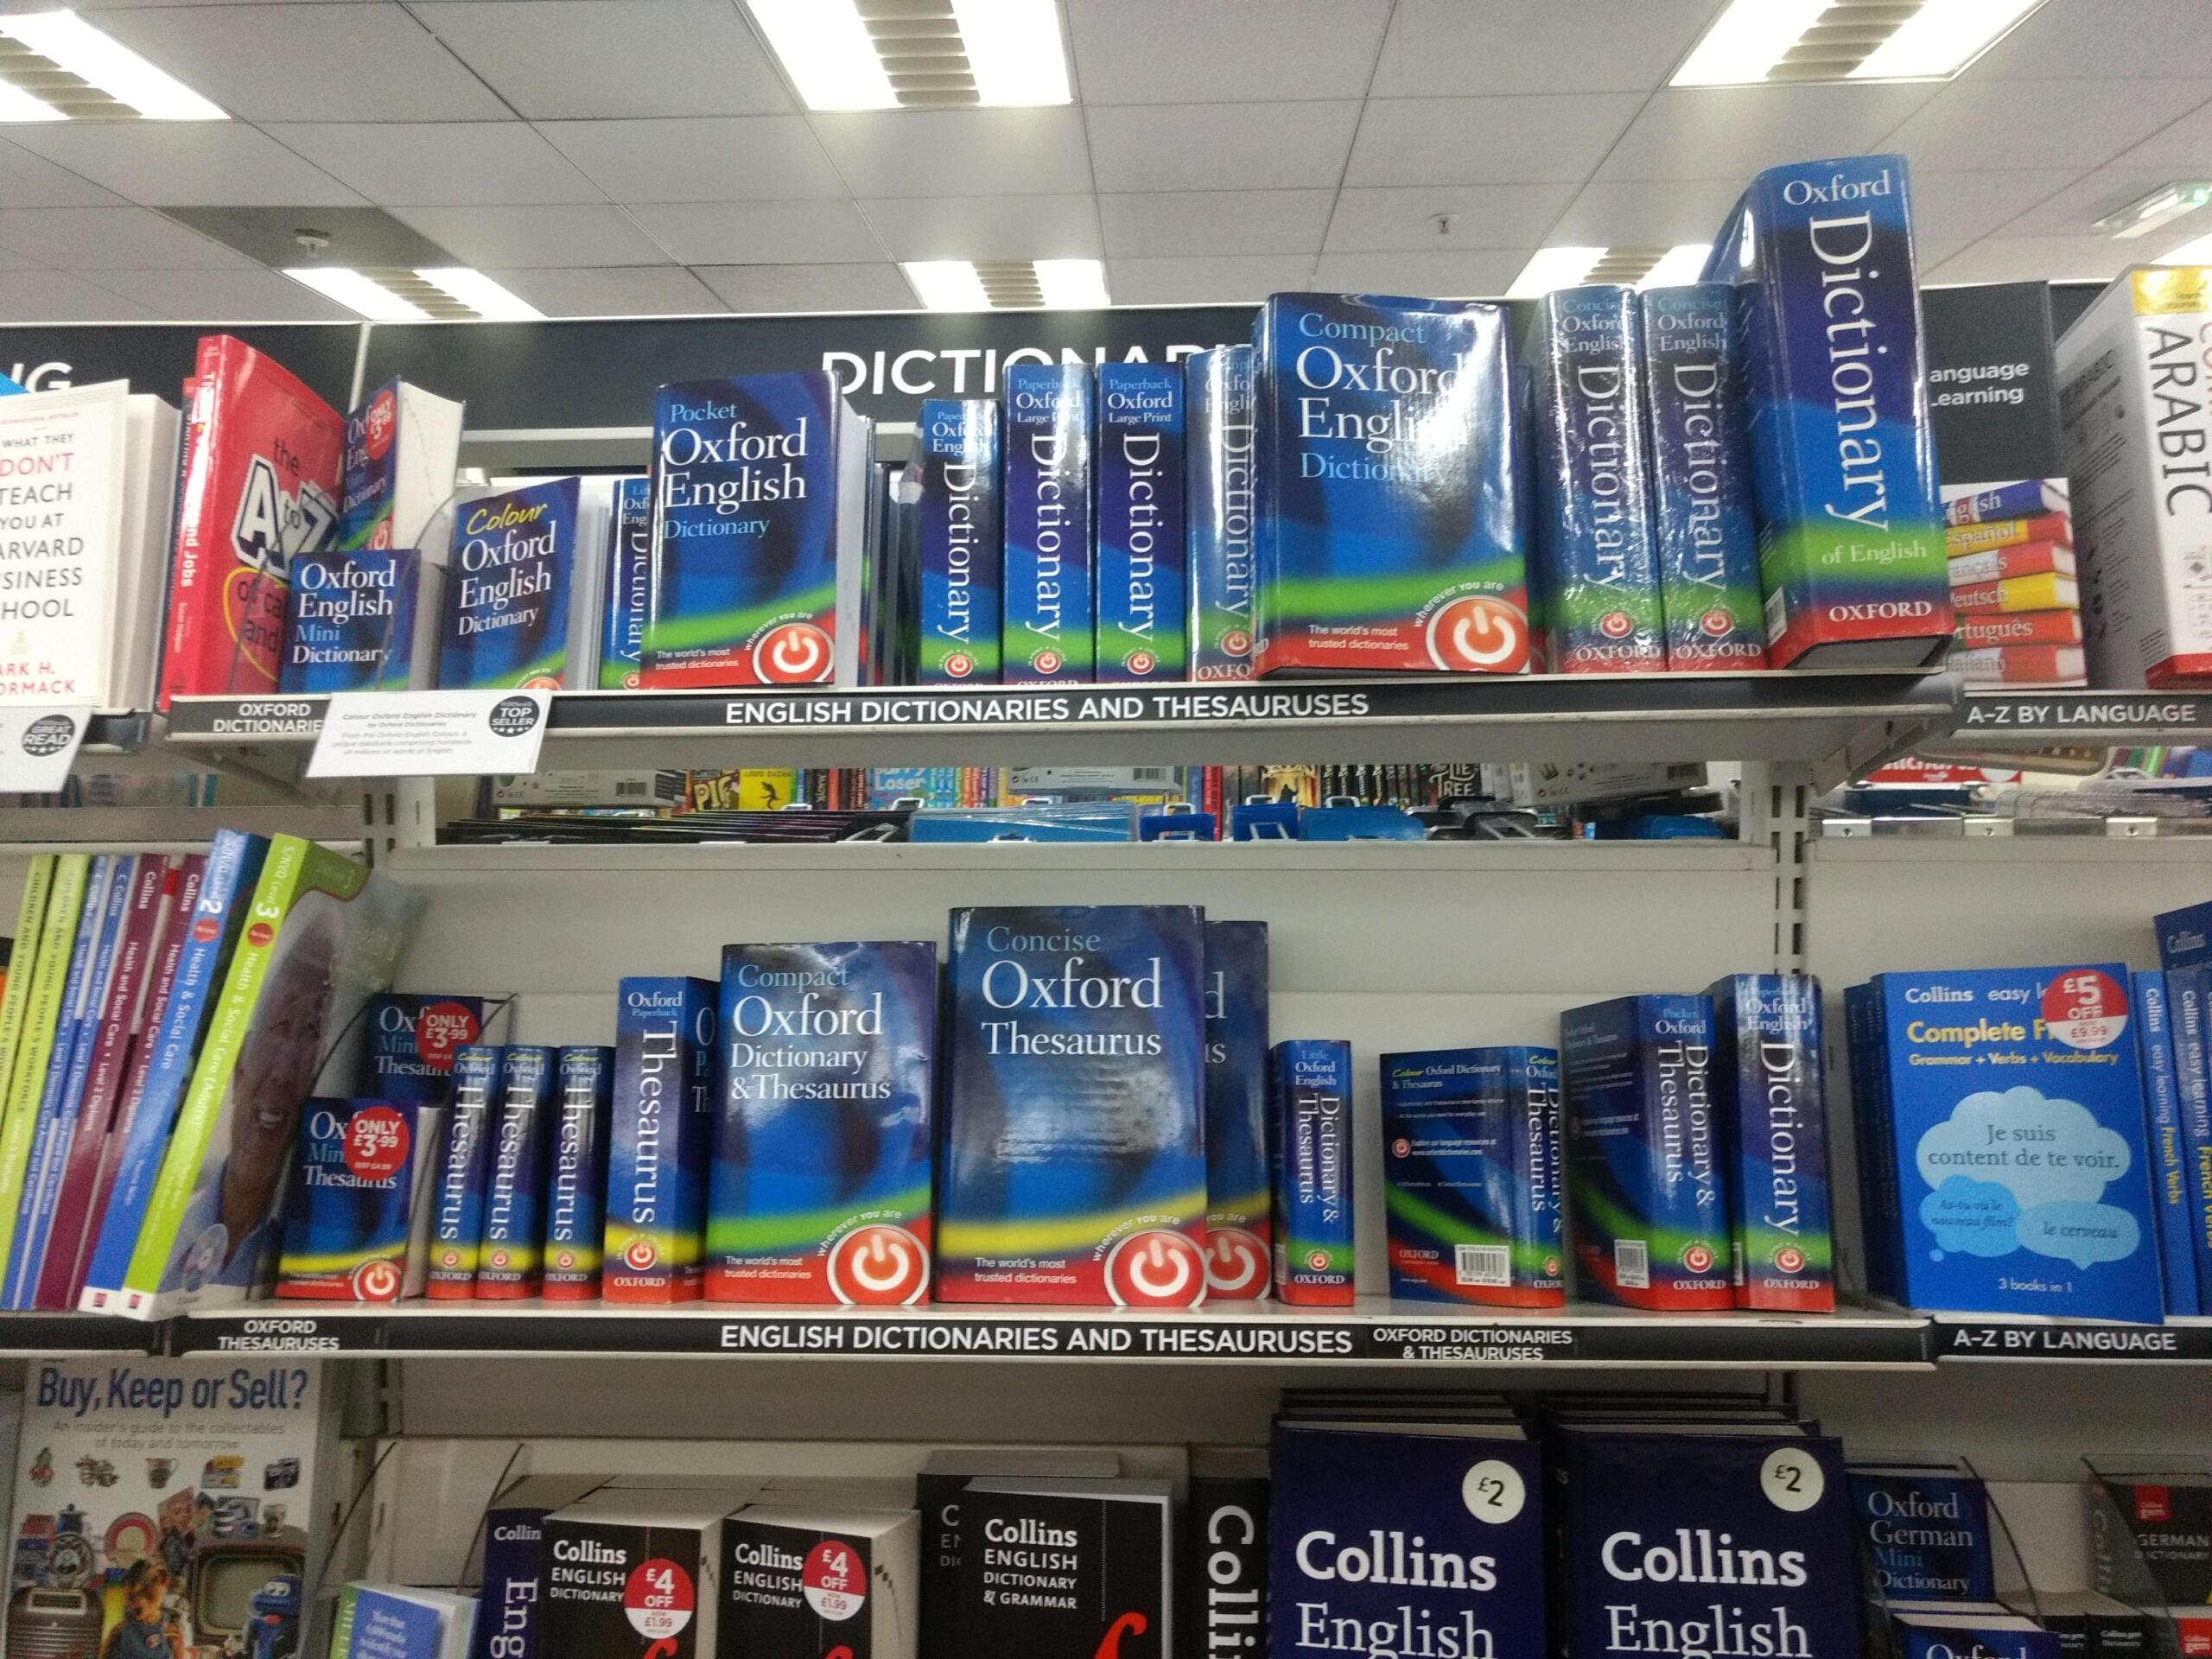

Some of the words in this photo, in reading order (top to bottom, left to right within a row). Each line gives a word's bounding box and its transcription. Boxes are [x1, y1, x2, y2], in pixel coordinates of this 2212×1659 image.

[1783, 169, 1892, 206] Oxford
[1298, 313, 1426, 346] Compact
[1658, 312, 1726, 331] Oxford
[1661, 333, 1726, 353] English
[1296, 346, 1467, 395] Oxford
[1809, 211, 1888, 531] Dictionary
[670, 402, 737, 423] Pocket
[1107, 392, 1173, 410] Oxford
[1109, 412, 1141, 424] Large
[1143, 410, 1173, 423] Print
[2146, 327, 2212, 517] ARABIC
[3, 437, 38, 448] WHAT
[45, 434, 73, 445] THEY
[663, 417, 808, 467] Oxford
[664, 463, 806, 515] English
[1577, 365, 1626, 592] Dictionary
[1673, 364, 1728, 592] Dictionary
[41, 513, 65, 528] AT
[466, 503, 548, 535] Colour
[664, 520, 771, 540] Dictionary
[462, 521, 556, 572] Oxford
[1025, 433, 1071, 642] Dictionary
[1118, 433, 1164, 643] Dictionary
[938, 463, 979, 644] Dictionary
[1821, 543, 1846, 564] of
[1851, 540, 1927, 566] English
[181, 551, 199, 588] Jobs
[300, 561, 396, 589] Oxford
[458, 562, 551, 610] English
[298, 594, 392, 624] English
[458, 607, 539, 636] Dictionary
[1828, 601, 1932, 621] OXFORD
[296, 625, 340, 642] Mini
[1309, 625, 1329, 635] The
[1332, 626, 1369, 636] world's
[1371, 627, 1397, 637] most
[1309, 639, 1346, 649] trusted
[1349, 639, 1409, 651] dictionaries
[1676, 644, 1762, 659] OXFORD
[239, 703, 311, 718] OXFORD
[499, 708, 531, 718] TOP
[726, 702, 850, 724] ENGLISH
[863, 698, 1069, 722] DICTIONARIES
[1078, 696, 1144, 720] AND
[1156, 694, 1370, 718] THESAURUSES
[1967, 706, 2012, 724] A-Z
[2018, 706, 2048, 723] BY
[2057, 705, 2196, 723] LANGUAGE
[492, 717, 535, 728] SELLER
[22, 733, 72, 747] READ
[874, 777, 924, 791] Loser
[1428, 770, 1476, 798] TREE
[138, 871, 157, 909] Collins
[181, 874, 200, 912] Collins
[200, 899, 223, 914] 2
[255, 902, 280, 918] 3
[988, 926, 1101, 953] Concise
[185, 948, 207, 987] Health
[738, 964, 849, 993] Compact
[982, 957, 1164, 1009] Oxford
[1904, 986, 1974, 1003] Collins
[1987, 988, 2031, 1004] easy
[2063, 976, 2101, 1006] £5
[628, 991, 683, 1007] Oxford
[170, 1004, 192, 1039] Social
[426, 1015, 470, 1028] ONLY
[733, 993, 884, 1037] Oxford
[2068, 1006, 2102, 1020] OFF
[982, 1021, 1162, 1056] Thesaurus
[1655, 1020, 1707, 1034] Oxford
[1907, 1018, 2026, 1048] Complete
[730, 1043, 868, 1075] Dictionary
[1295, 1061, 1336, 1072] Oxford
[1909, 1054, 1973, 1065] Grammar
[2043, 1051, 2118, 1065] Vocabulary
[1295, 1075, 1337, 1088] English
[632, 1020, 677, 1224] Thesaurus
[1658, 1041, 1685, 1183] Thesaurus
[1685, 1046, 1716, 1187] Dictionary
[355, 1119, 401, 1135] ONLY
[1760, 1041, 1803, 1236] Dictionary
[1986, 1124, 2006, 1145] Je
[2012, 1124, 2056, 1141] suis
[441, 1077, 486, 1241] Thesaurus
[489, 1077, 536, 1241] Thesaurus
[554, 1077, 594, 1242] Thesaurus
[1299, 1093, 1319, 1204] Thesaurus
[1318, 1097, 1340, 1208] Dictionary
[1928, 1150, 2009, 1166] content
[2015, 1148, 2042, 1166] de
[2047, 1153, 2068, 1166] te
[2074, 1151, 2120, 1167] voir.
[2162, 1127, 2179, 1166] French
[1696, 1190, 1716, 1206] &
[2166, 1171, 2183, 1205] Verbs
[2060, 1225, 2118, 1238] cerveau
[975, 1257, 995, 1268] The
[998, 1258, 1036, 1268] world's
[1039, 1259, 1066, 1268] most
[614, 1276, 665, 1287] OXFORD
[975, 1273, 1012, 1282] trusted
[1014, 1273, 1077, 1284] dictionaries
[1294, 1274, 1344, 1284] OXFORD
[1674, 1279, 1726, 1290] OXFORD
[1764, 1279, 1819, 1290] OXFORD
[1999, 1278, 2008, 1289] 3
[2010, 1278, 2046, 1292] books
[244, 1320, 316, 1334] OXFORD
[721, 1325, 842, 1351] ENGLISH
[853, 1326, 1059, 1351] DICTIONARIES
[1066, 1328, 1131, 1352] AND
[1140, 1329, 1353, 1354] THESAURUSES
[1374, 1328, 1446, 1344] OXFORD
[1450, 1330, 1573, 1345] DICTIONARIES
[218, 1336, 339, 1351] THESAURUSES
[1402, 1346, 1414, 1360] &
[1418, 1346, 1544, 1361] THESAURUSES
[1953, 1330, 1997, 1347] A-Z
[2004, 1332, 2037, 1348] BY
[2044, 1331, 2177, 1351] LANGUAGE
[38, 1367, 100, 1417] Buy,
[107, 1369, 183, 1418] Keep
[193, 1376, 225, 1406] or
[228, 1370, 308, 1409] Sell?
[130, 1422, 163, 1437] guide
[177, 1439, 238, 1450] tomorrow
[1477, 1476, 1505, 1507] £2
[1774, 1465, 1802, 1493] £2
[1867, 1491, 1959, 1518] Oxford
[984, 1517, 1078, 1548] Collins
[1870, 1520, 1973, 1548] German
[553, 1539, 626, 1565] Collins
[734, 1542, 804, 1571] Collins
[823, 1548, 849, 1577] £4
[984, 1548, 1078, 1571] ENGLISH
[1295, 1530, 1497, 1591] Collins
[1601, 1528, 1808, 1587] Collins
[551, 1567, 626, 1586] ENGLISH
[645, 1567, 675, 1595] £4
[734, 1570, 803, 1592] ENGLISH
[822, 1575, 848, 1591] OFF
[983, 1571, 1077, 1590] DICTIONARY
[1873, 1569, 1970, 1592] Dictionary
[550, 1587, 624, 1603] DICTIONARY
[645, 1595, 673, 1608] OFF
[732, 1590, 802, 1609] DICTIONARY
[983, 1589, 996, 1605] &
[1000, 1592, 1077, 1609] GRAMMAR
[1295, 1601, 1497, 1659] English
[1604, 1605, 1815, 1659] English
